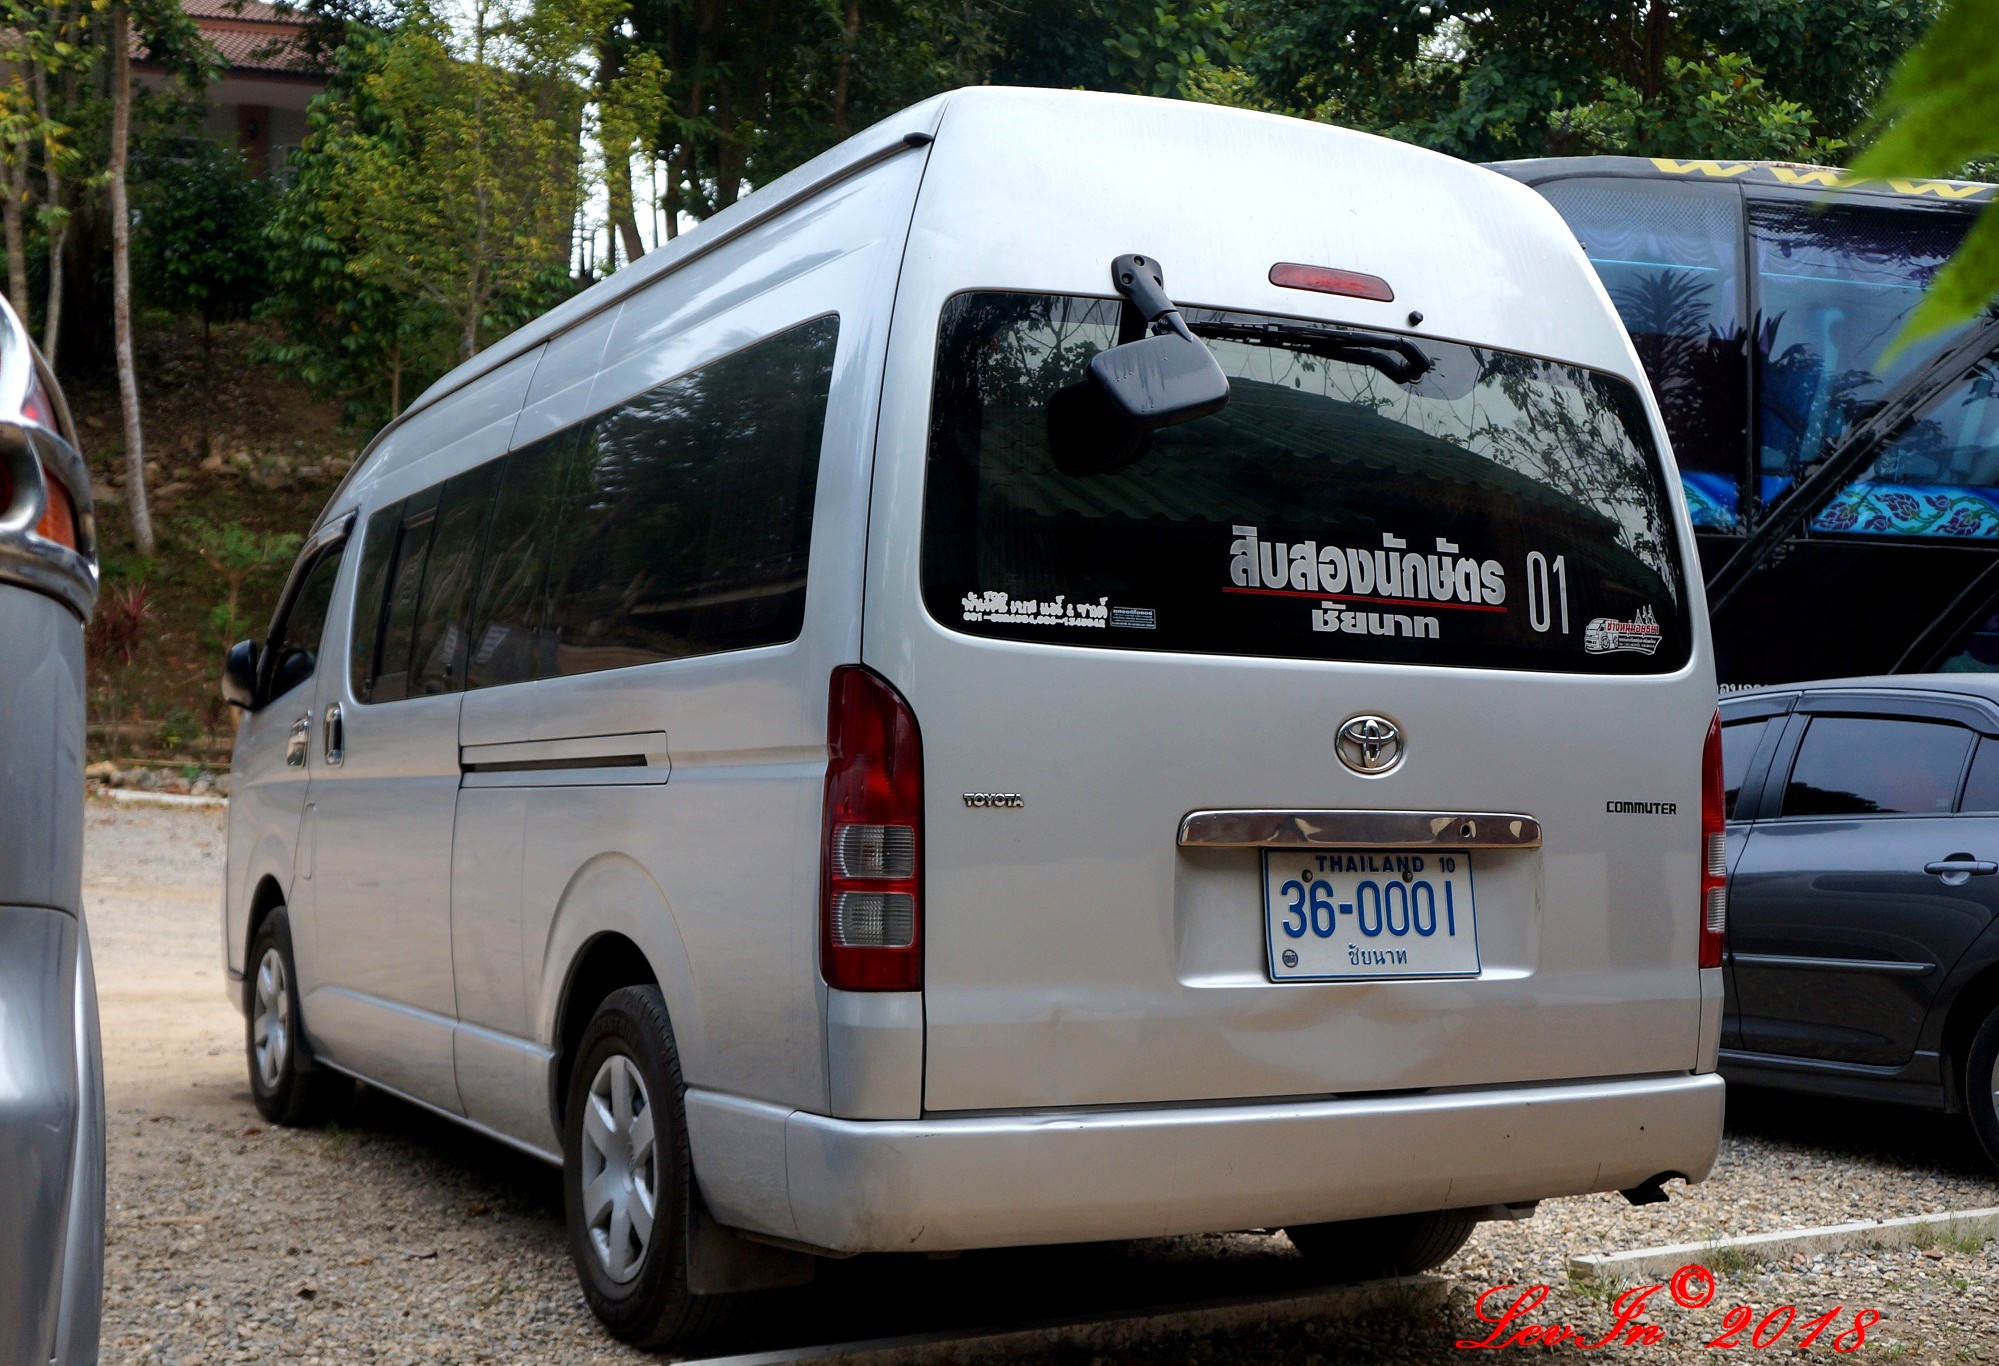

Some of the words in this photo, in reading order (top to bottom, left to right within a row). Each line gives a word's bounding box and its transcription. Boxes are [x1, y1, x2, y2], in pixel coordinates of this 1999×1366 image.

[1229, 524, 1507, 606] สิบสองนักษัตร
[1526, 550, 1569, 635] 01
[1311, 600, 1440, 639] ชัยนาท
[963, 792, 1024, 807] TOYOTA
[1606, 801, 1677, 815] COMMUTER
[1315, 855, 1425, 873] THAILAND
[1438, 857, 1456, 873] 10
[1281, 879, 1457, 938] 36-0001
[1348, 942, 1408, 966] ชัยนาท
